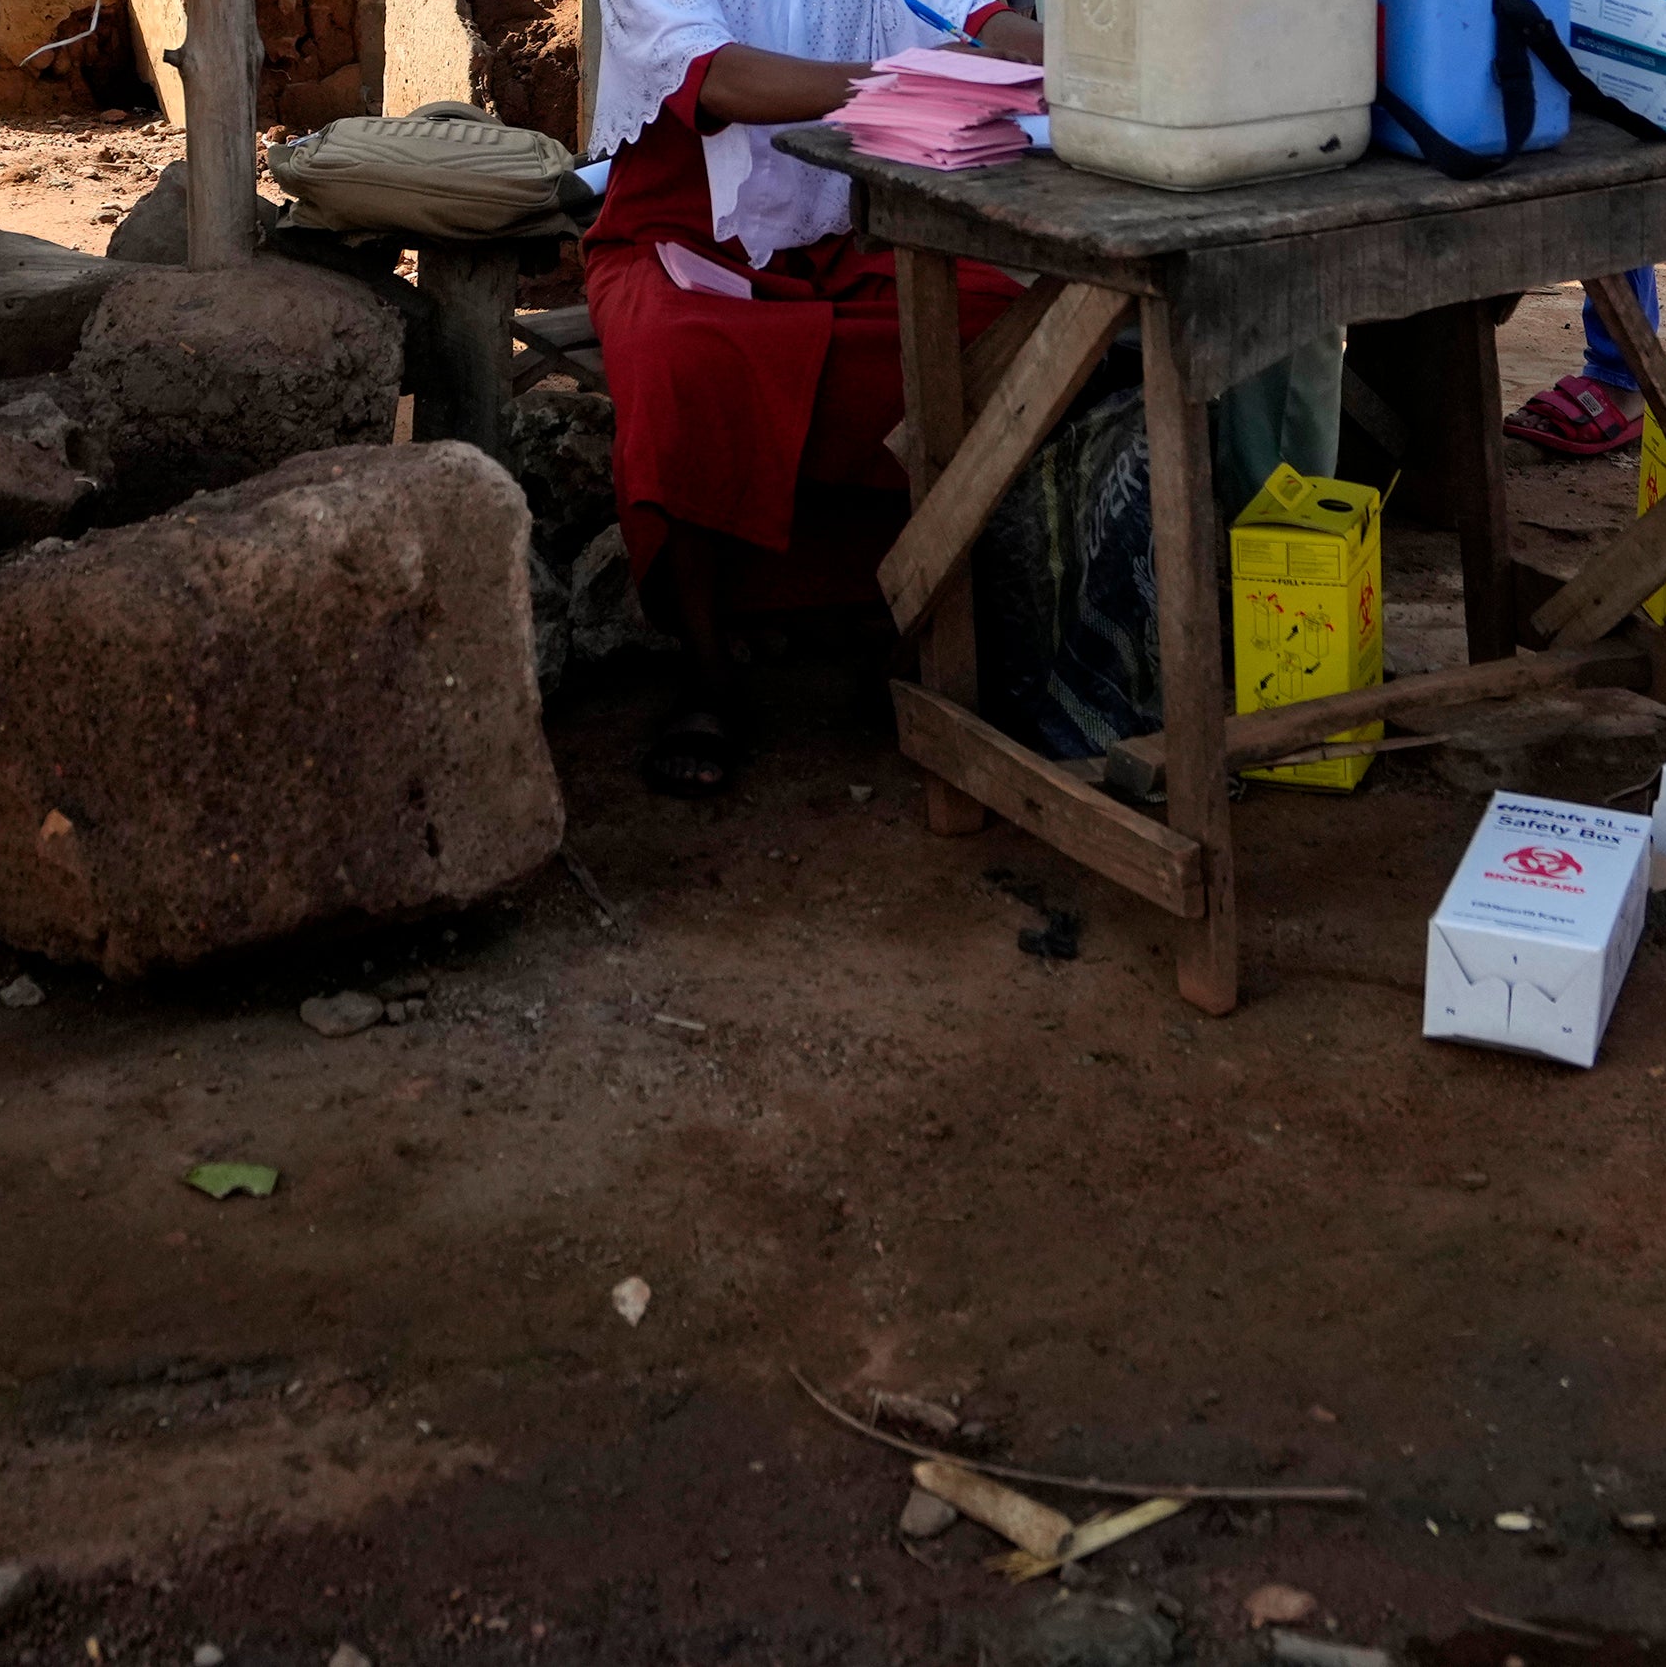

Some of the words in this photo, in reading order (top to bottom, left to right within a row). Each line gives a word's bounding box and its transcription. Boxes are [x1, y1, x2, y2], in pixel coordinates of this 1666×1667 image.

[1277, 578, 1299, 587] FULL
[1498, 815, 1571, 835] Safety
[1579, 829, 1621, 845] Box
[1484, 871, 1585, 894] BIOHAZARD
